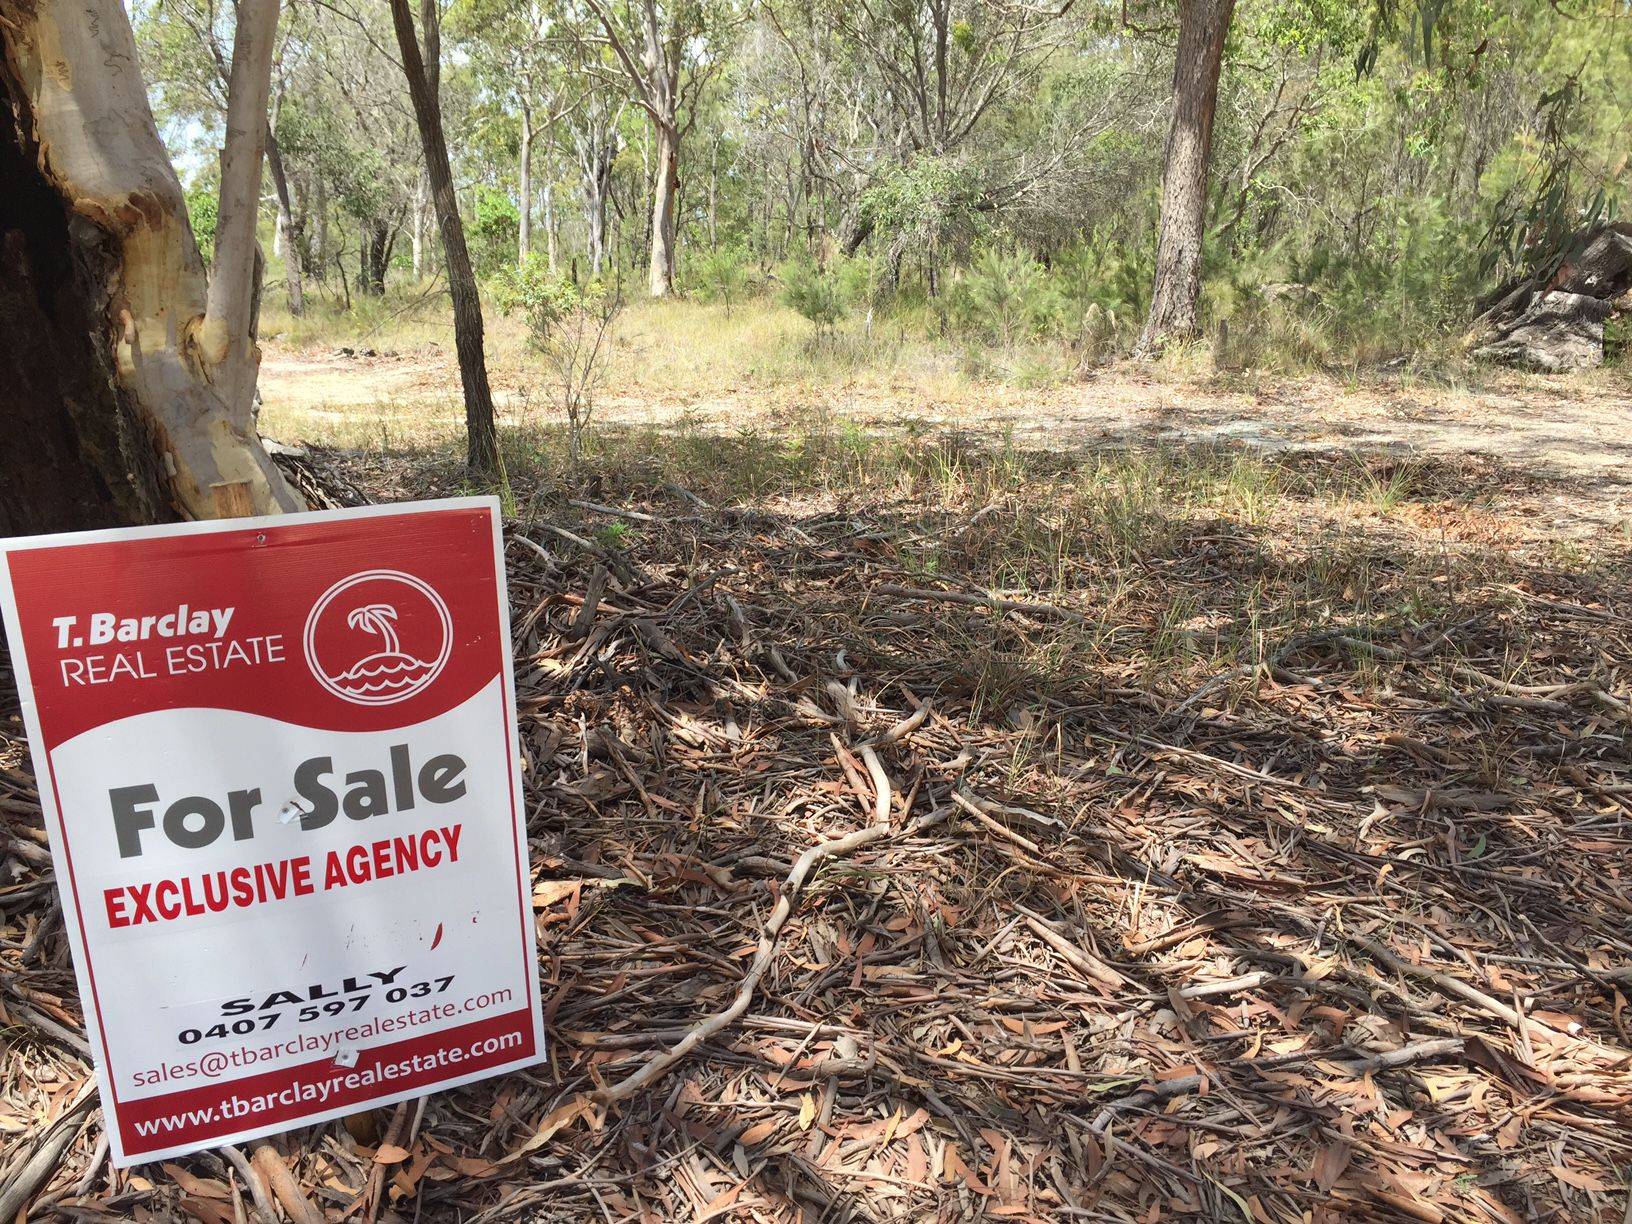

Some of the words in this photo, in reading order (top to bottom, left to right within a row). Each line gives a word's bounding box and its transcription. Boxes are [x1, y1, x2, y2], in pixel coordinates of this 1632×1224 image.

[61, 651, 157, 687] REAL
[167, 634, 286, 676] ESTATE
[109, 783, 262, 859] For
[294, 743, 467, 831] Sale
[103, 856, 314, 928] EXCLUSIVE
[324, 824, 462, 891] AGENCY
[133, 986, 513, 1087] sales@tbarclayrealestate.com
[178, 1014, 281, 1045] 0407
[299, 998, 371, 1023] 597
[385, 975, 456, 1003] 037
[221, 965, 408, 1017] SALLY
[134, 1029, 522, 1137] www.tbarclayrealestate.com
